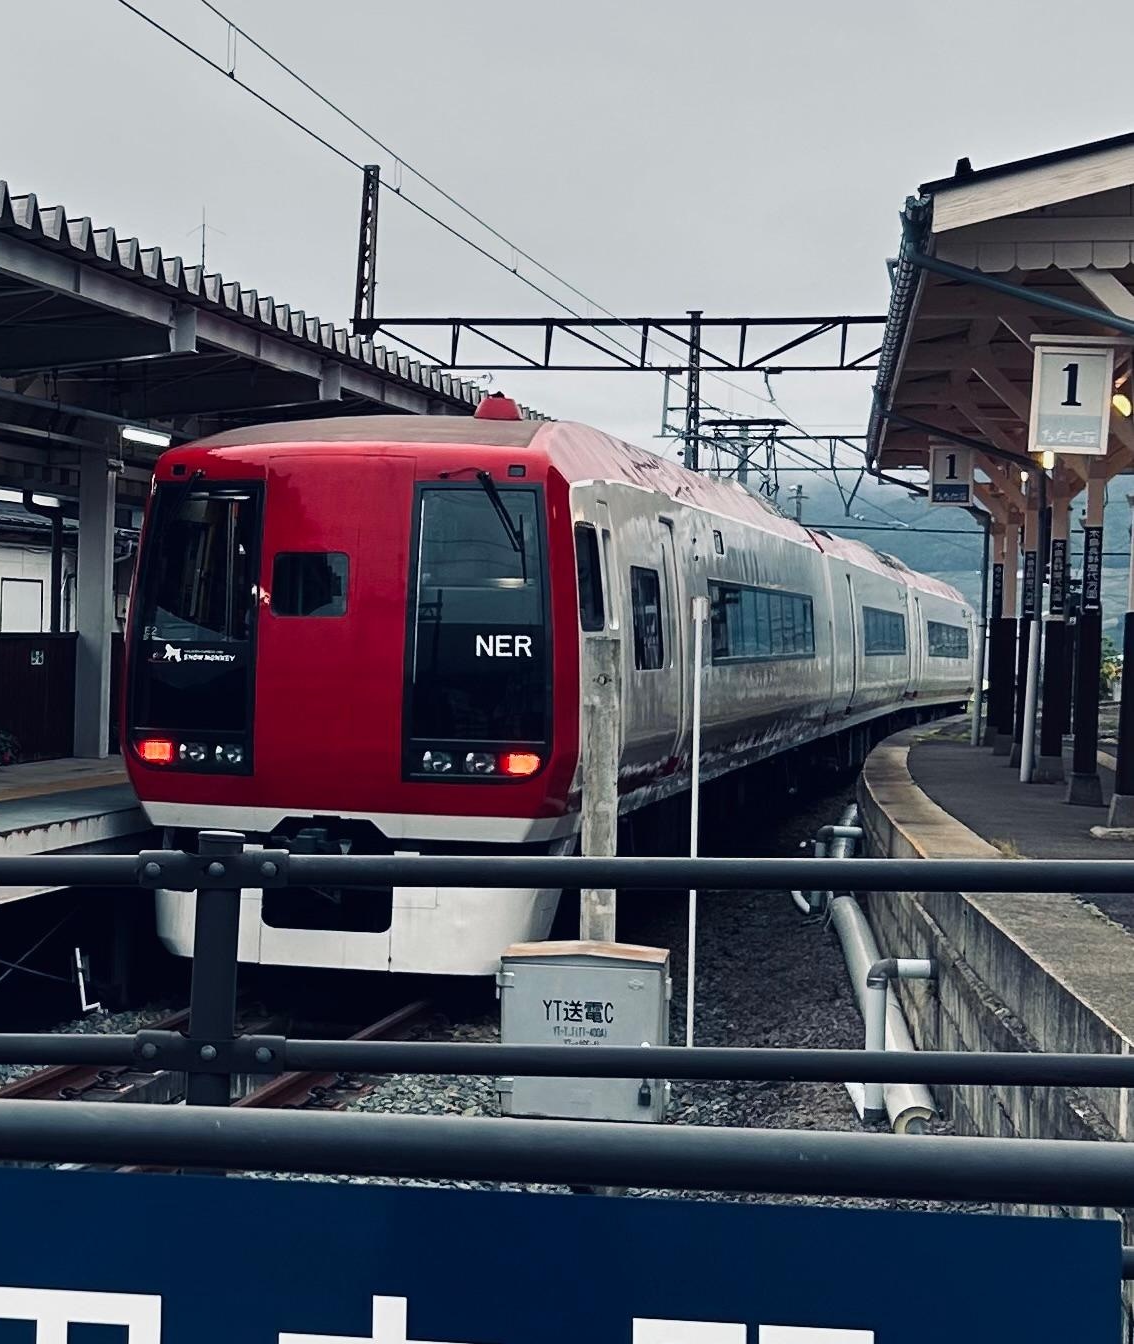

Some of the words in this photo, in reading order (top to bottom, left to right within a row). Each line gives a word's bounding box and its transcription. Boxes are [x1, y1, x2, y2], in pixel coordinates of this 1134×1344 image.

[1061, 363, 1082, 407] 1
[946, 453, 958, 479] 1
[476, 635, 532, 657] NER
[543, 1000, 614, 1023] YT送電C
